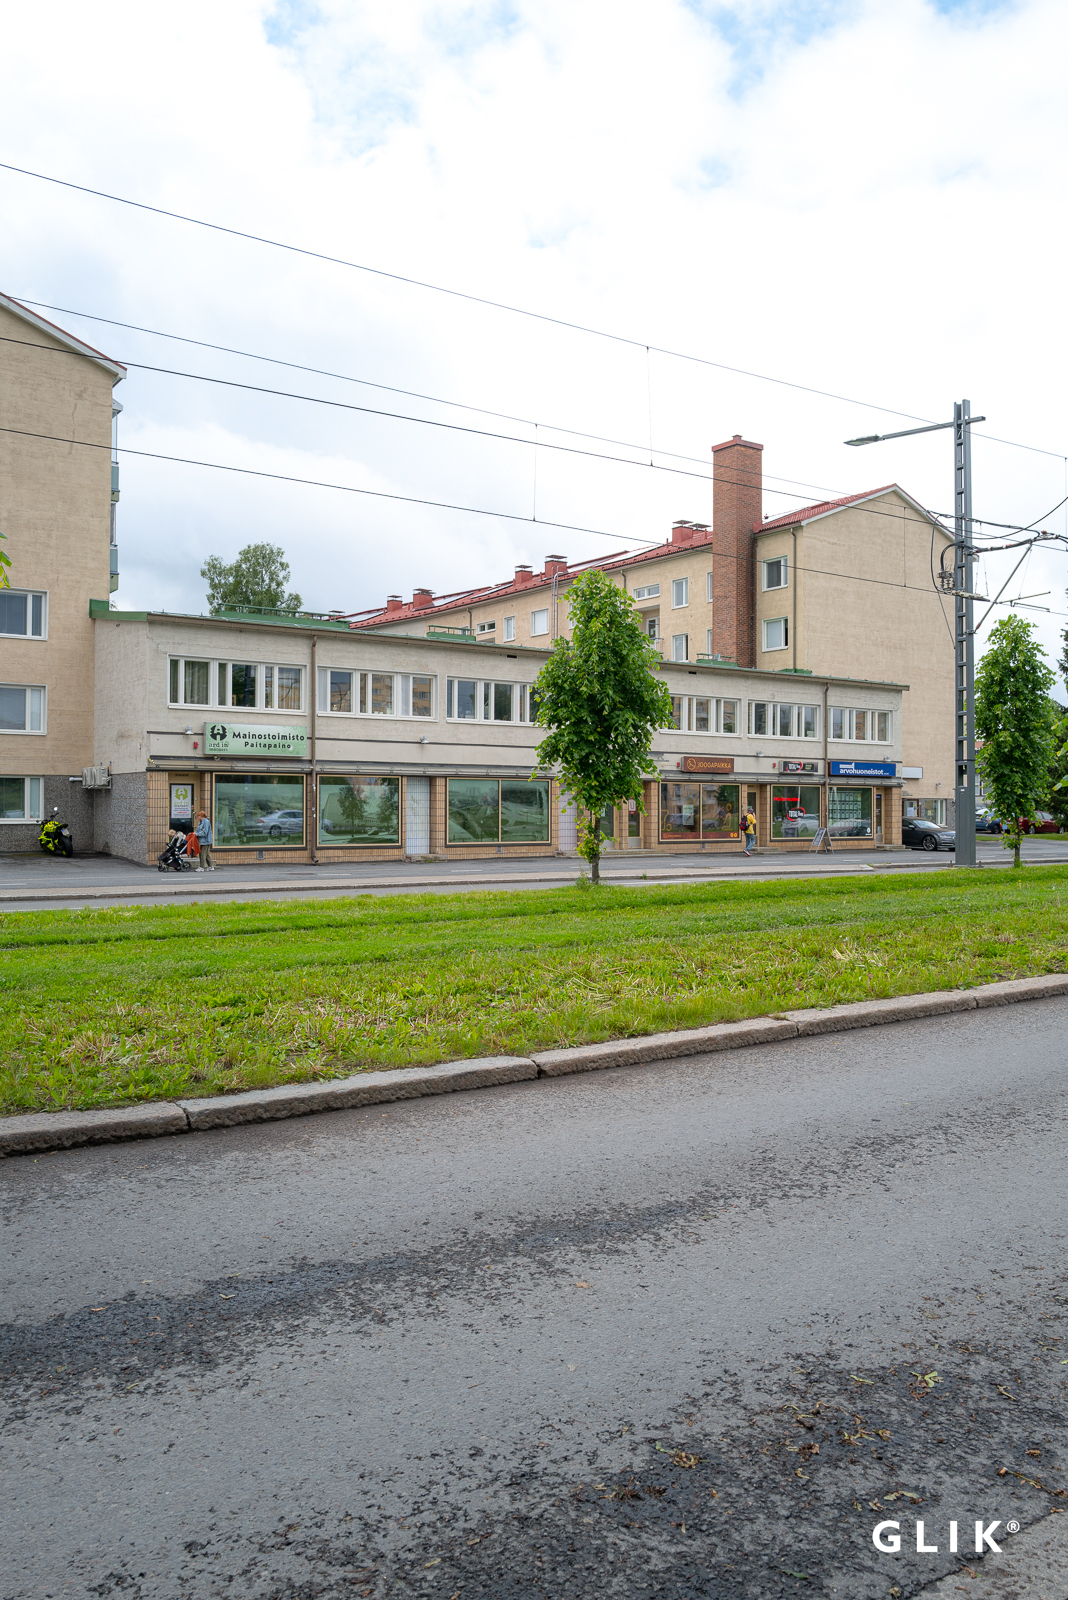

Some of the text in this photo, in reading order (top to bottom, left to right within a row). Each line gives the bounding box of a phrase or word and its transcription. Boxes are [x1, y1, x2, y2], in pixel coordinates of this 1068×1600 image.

[232, 731, 305, 741] Mainostoimisto
[244, 741, 291, 750] Paitapaino
[839, 767, 884, 775] arvohuoneistot
